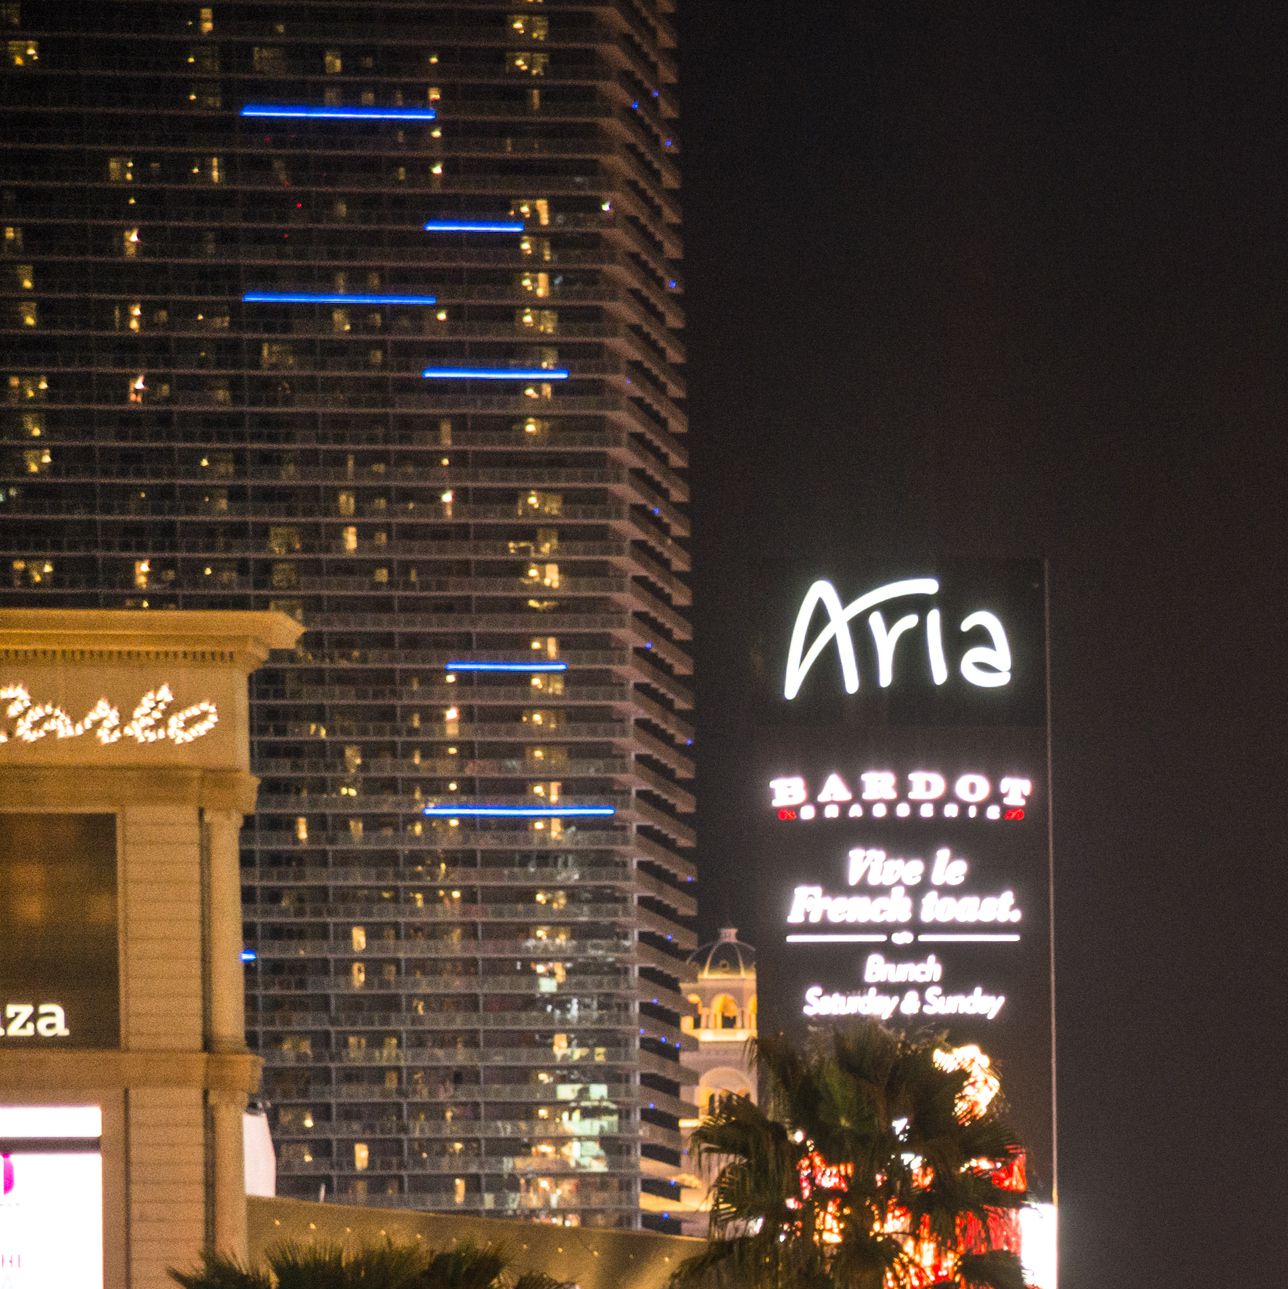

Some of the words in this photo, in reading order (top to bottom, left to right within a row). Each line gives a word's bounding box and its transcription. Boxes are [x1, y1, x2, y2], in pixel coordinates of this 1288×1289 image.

[785, 578, 1012, 700] Aria
[769, 772, 1032, 808] BARDOT
[847, 847, 924, 887] Vive
[931, 848, 969, 886] le
[786, 886, 913, 924] French
[919, 891, 1023, 924] toast.
[864, 954, 942, 983] Brunch
[0, 1003, 70, 1038] za
[803, 987, 898, 1019] Saturday
[900, 988, 920, 1015] &
[922, 987, 1005, 1020] Sunday
